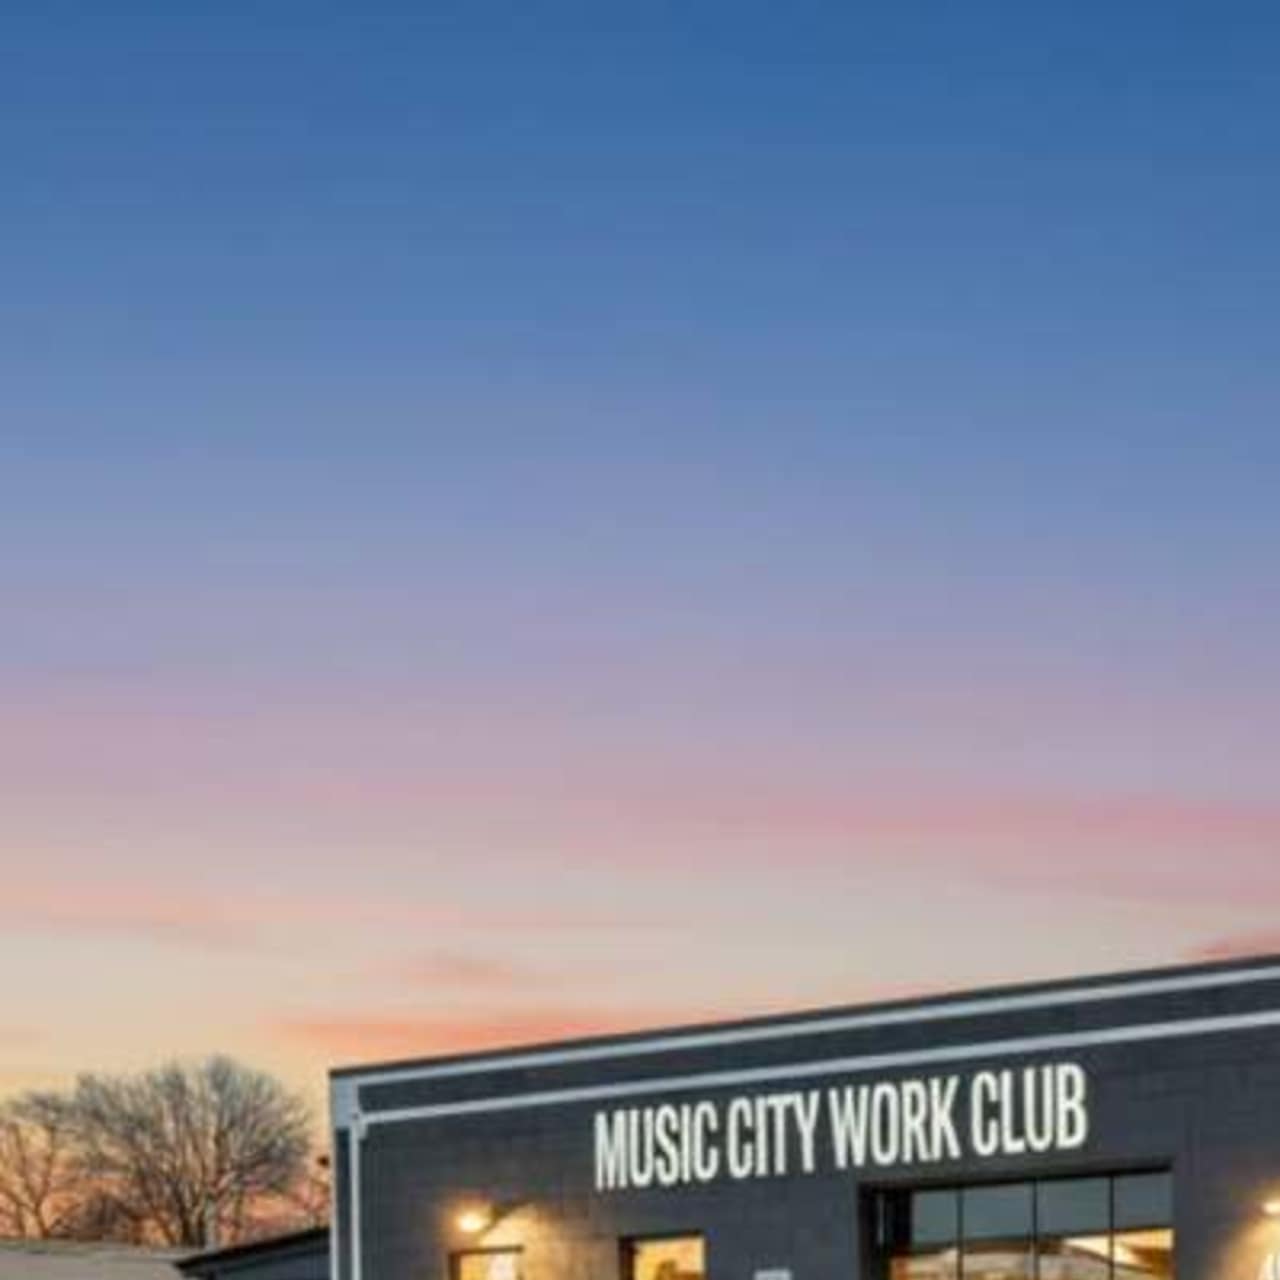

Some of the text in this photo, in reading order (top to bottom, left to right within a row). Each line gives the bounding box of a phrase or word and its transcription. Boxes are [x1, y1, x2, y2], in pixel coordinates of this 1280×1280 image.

[593, 1062, 1089, 1191] MUSIC CITY WORK CLUB
